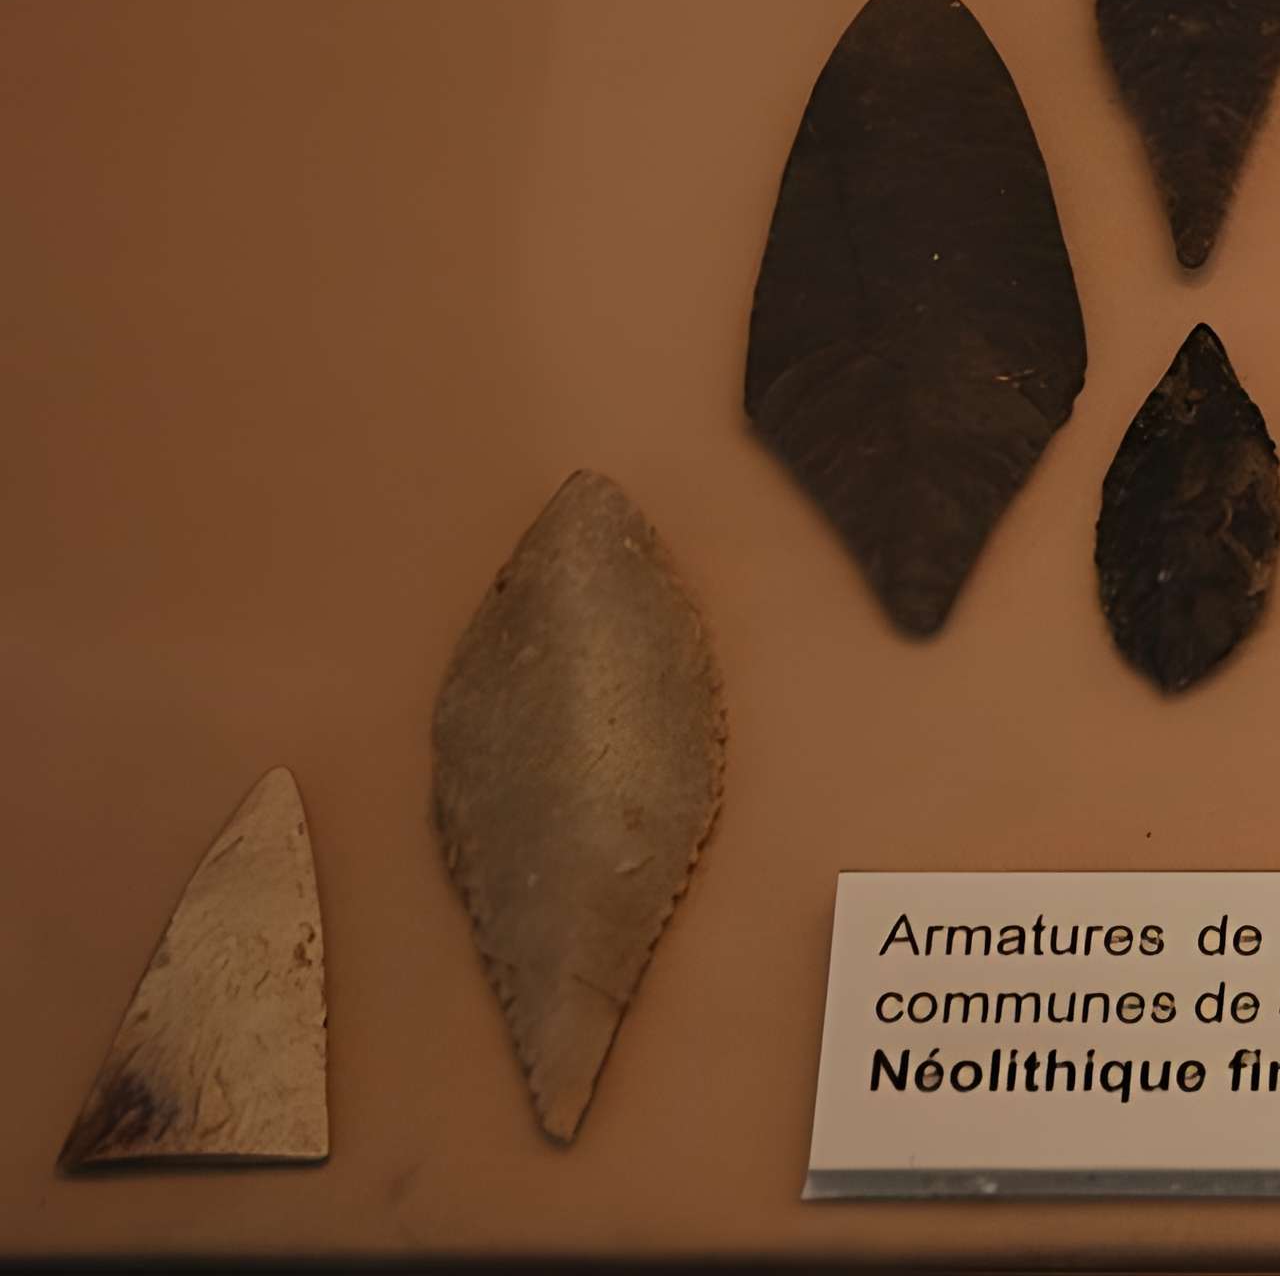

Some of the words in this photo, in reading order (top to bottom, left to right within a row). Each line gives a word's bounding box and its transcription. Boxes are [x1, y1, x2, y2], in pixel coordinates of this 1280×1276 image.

[878, 913, 1165, 957] Armatures
[1197, 914, 1263, 957] de
[875, 991, 1177, 1025] communes
[1194, 981, 1261, 1024] de
[870, 1047, 1207, 1104] Néolithique
